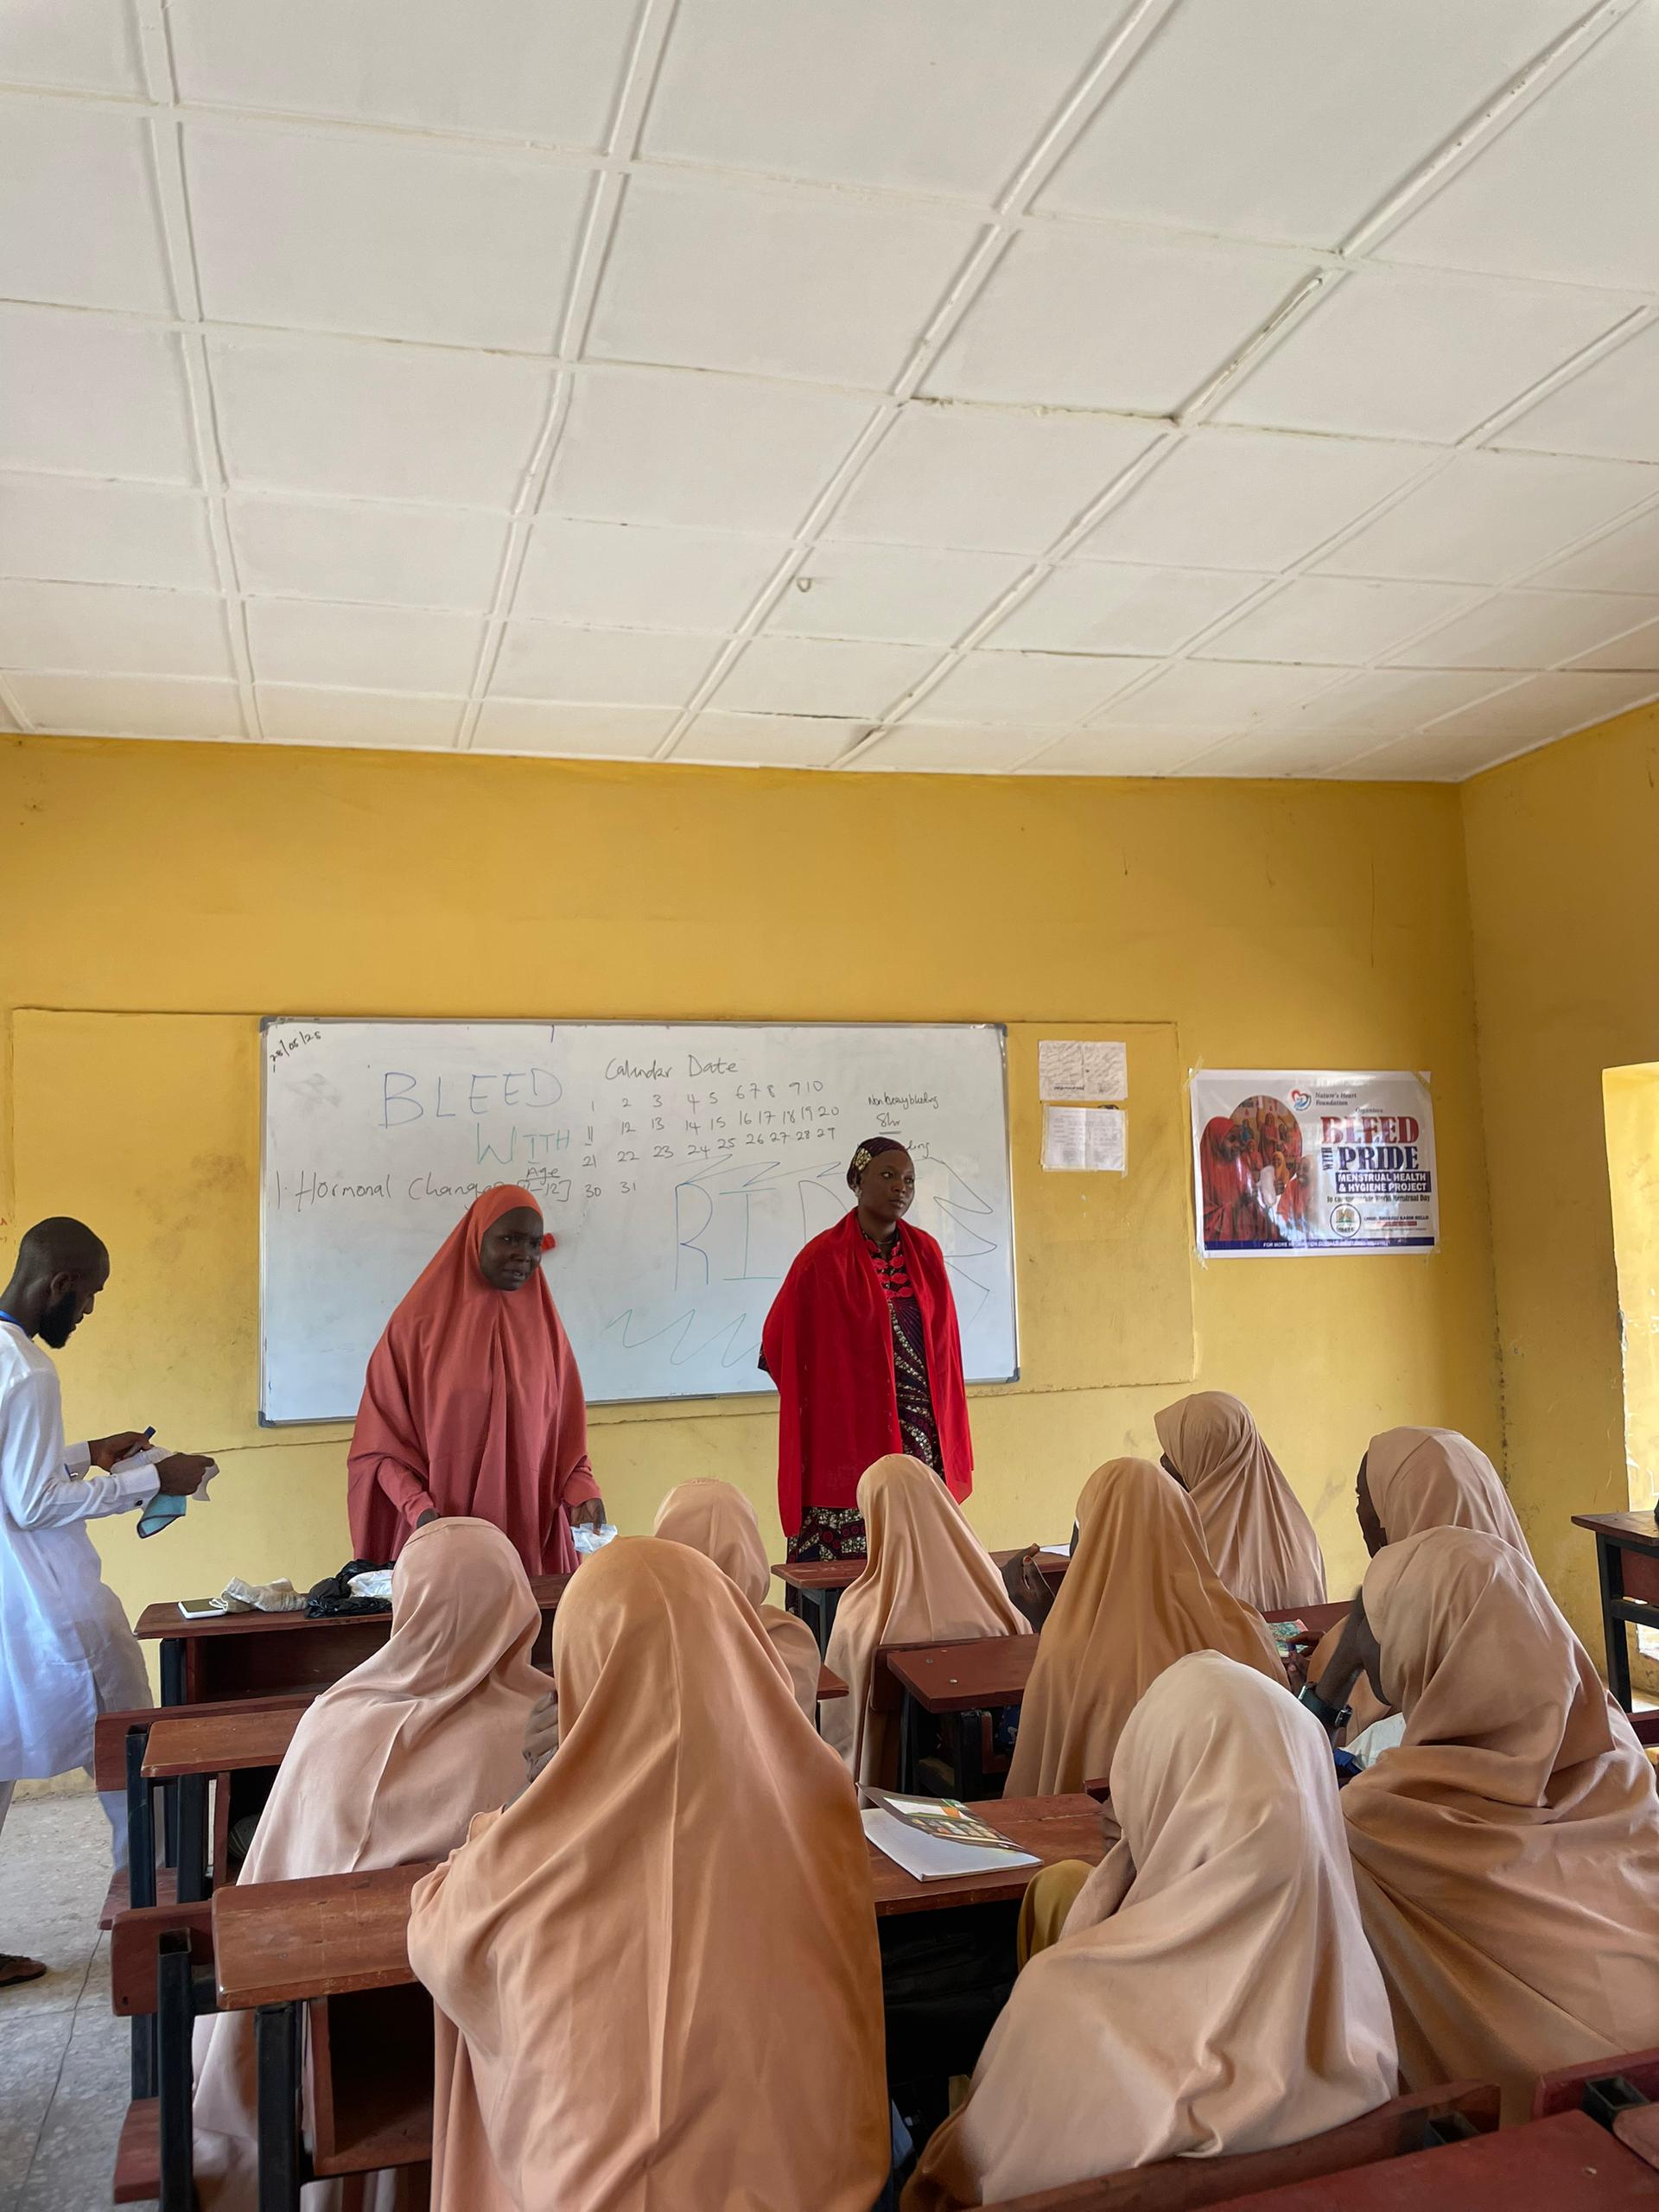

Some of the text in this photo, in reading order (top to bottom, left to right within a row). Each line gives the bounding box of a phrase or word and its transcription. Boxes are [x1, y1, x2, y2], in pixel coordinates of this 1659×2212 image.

[688, 1054, 739, 1077] Date
[378, 1067, 563, 1129] BLEED
[622, 1097, 632, 1107] 2
[652, 1094, 664, 1108] 3
[687, 1093, 701, 1114] 4
[709, 1092, 719, 1104] 5
[735, 1084, 746, 1100] 6
[748, 1083, 761, 1099] 7
[766, 1084, 776, 1098] 8
[806, 1080, 823, 1093] 10
[621, 1121, 637, 1134] 12
[652, 1117, 665, 1130] 13
[685, 1120, 702, 1135] 14
[710, 1116, 727, 1130] 15
[738, 1110, 753, 1125] 16
[759, 1110, 777, 1125] 17
[782, 1109, 796, 1123] 18
[801, 1106, 814, 1122] 19
[818, 1105, 840, 1118] 20
[1320, 1116, 1420, 1144] BLEED
[476, 1122, 572, 1165] WITH
[581, 1154, 597, 1168] 21
[617, 1150, 639, 1163] 22
[652, 1146, 675, 1159] 23
[687, 1145, 711, 1160] 24
[717, 1137, 736, 1150] 25
[746, 1133, 766, 1146] 26
[769, 1132, 791, 1145] 27
[796, 1130, 810, 1141] 28
[1337, 1146, 1420, 1171] PRIDE
[526, 1166, 560, 1185] Age
[1338, 1172, 1427, 1182] MENSTRUAL HEALTH
[1338, 1183, 1427, 1192] & HYGIENE PROJECT
[296, 1171, 391, 1212] Hormonal
[408, 1171, 505, 1199] Chang
[584, 1181, 637, 1198] 30 31
[1420, 1194, 1431, 1204] Day
